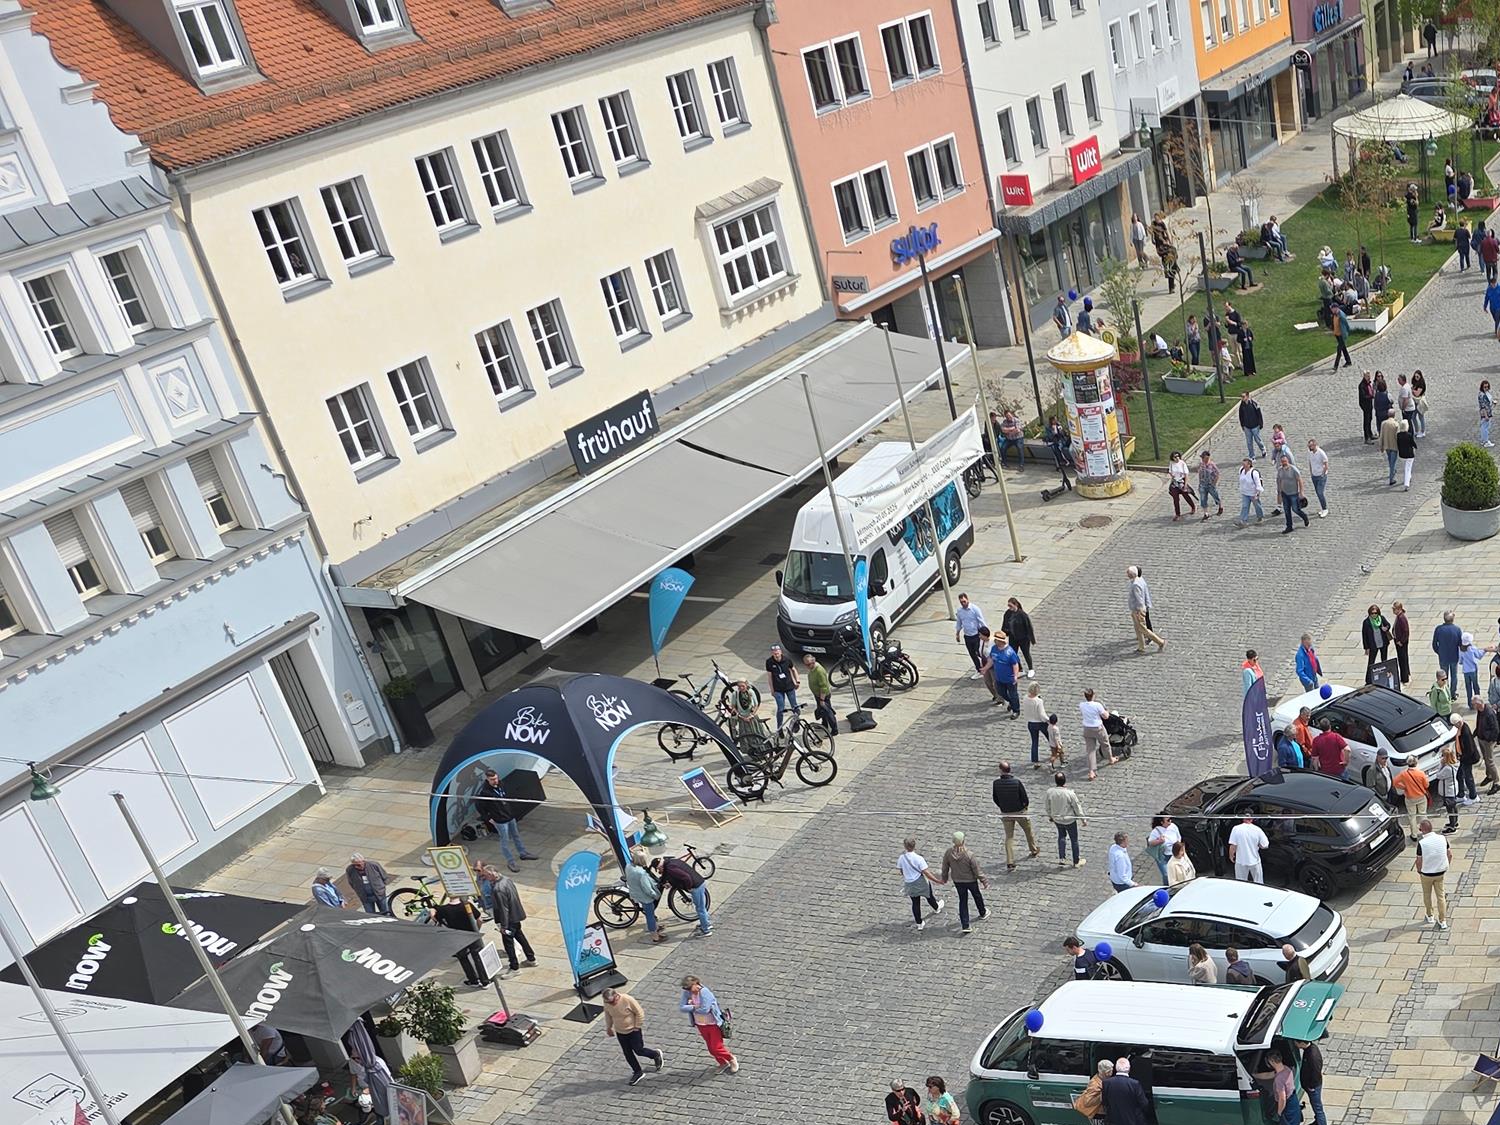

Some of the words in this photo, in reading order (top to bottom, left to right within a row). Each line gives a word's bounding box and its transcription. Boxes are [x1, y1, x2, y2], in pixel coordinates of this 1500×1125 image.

[577, 399, 653, 464] frühauf
[511, 705, 550, 728] Bike
[586, 693, 618, 719] Bike
[595, 699, 633, 732] NOW
[504, 722, 551, 745] NOW
[564, 871, 592, 890] NOW
[65, 936, 114, 990] now
[353, 946, 414, 985] now
